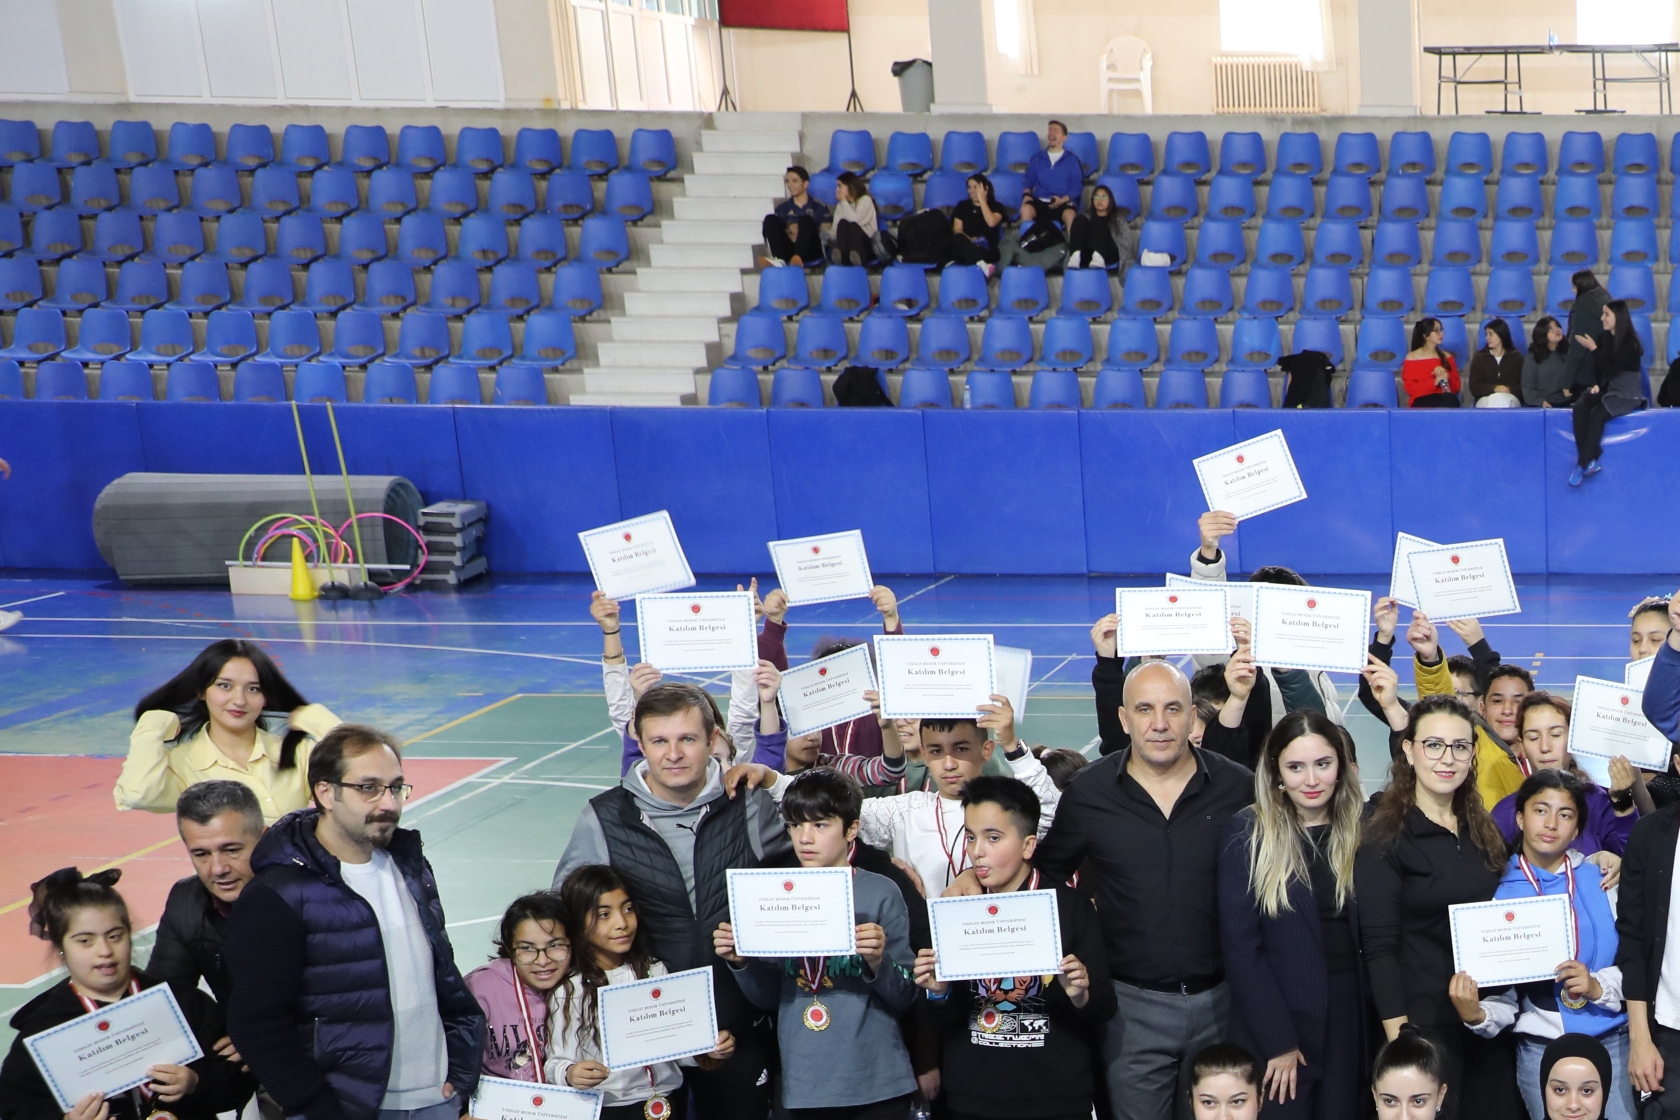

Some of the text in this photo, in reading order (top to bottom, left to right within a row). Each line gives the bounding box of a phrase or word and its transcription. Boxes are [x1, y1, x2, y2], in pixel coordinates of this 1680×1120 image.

[1224, 466, 1269, 485] Katılım Belgesi
[1435, 572, 1485, 583] Katılım Belgesi
[1282, 619, 1339, 629] Katılım Belgesi
[803, 678, 850, 697] Katılım Belgesi
[1596, 712, 1647, 727] Katılım Belgesi
[791, 904, 820, 912] Belgesi
[997, 925, 1027, 934] Belgesi
[1483, 931, 1541, 943] Katılım Belgesi
[629, 1006, 686, 1022] Katılım Belgesi
[78, 1028, 149, 1061] Katılım Belgesi
[978, 1040, 1032, 1048] COLLECTION
